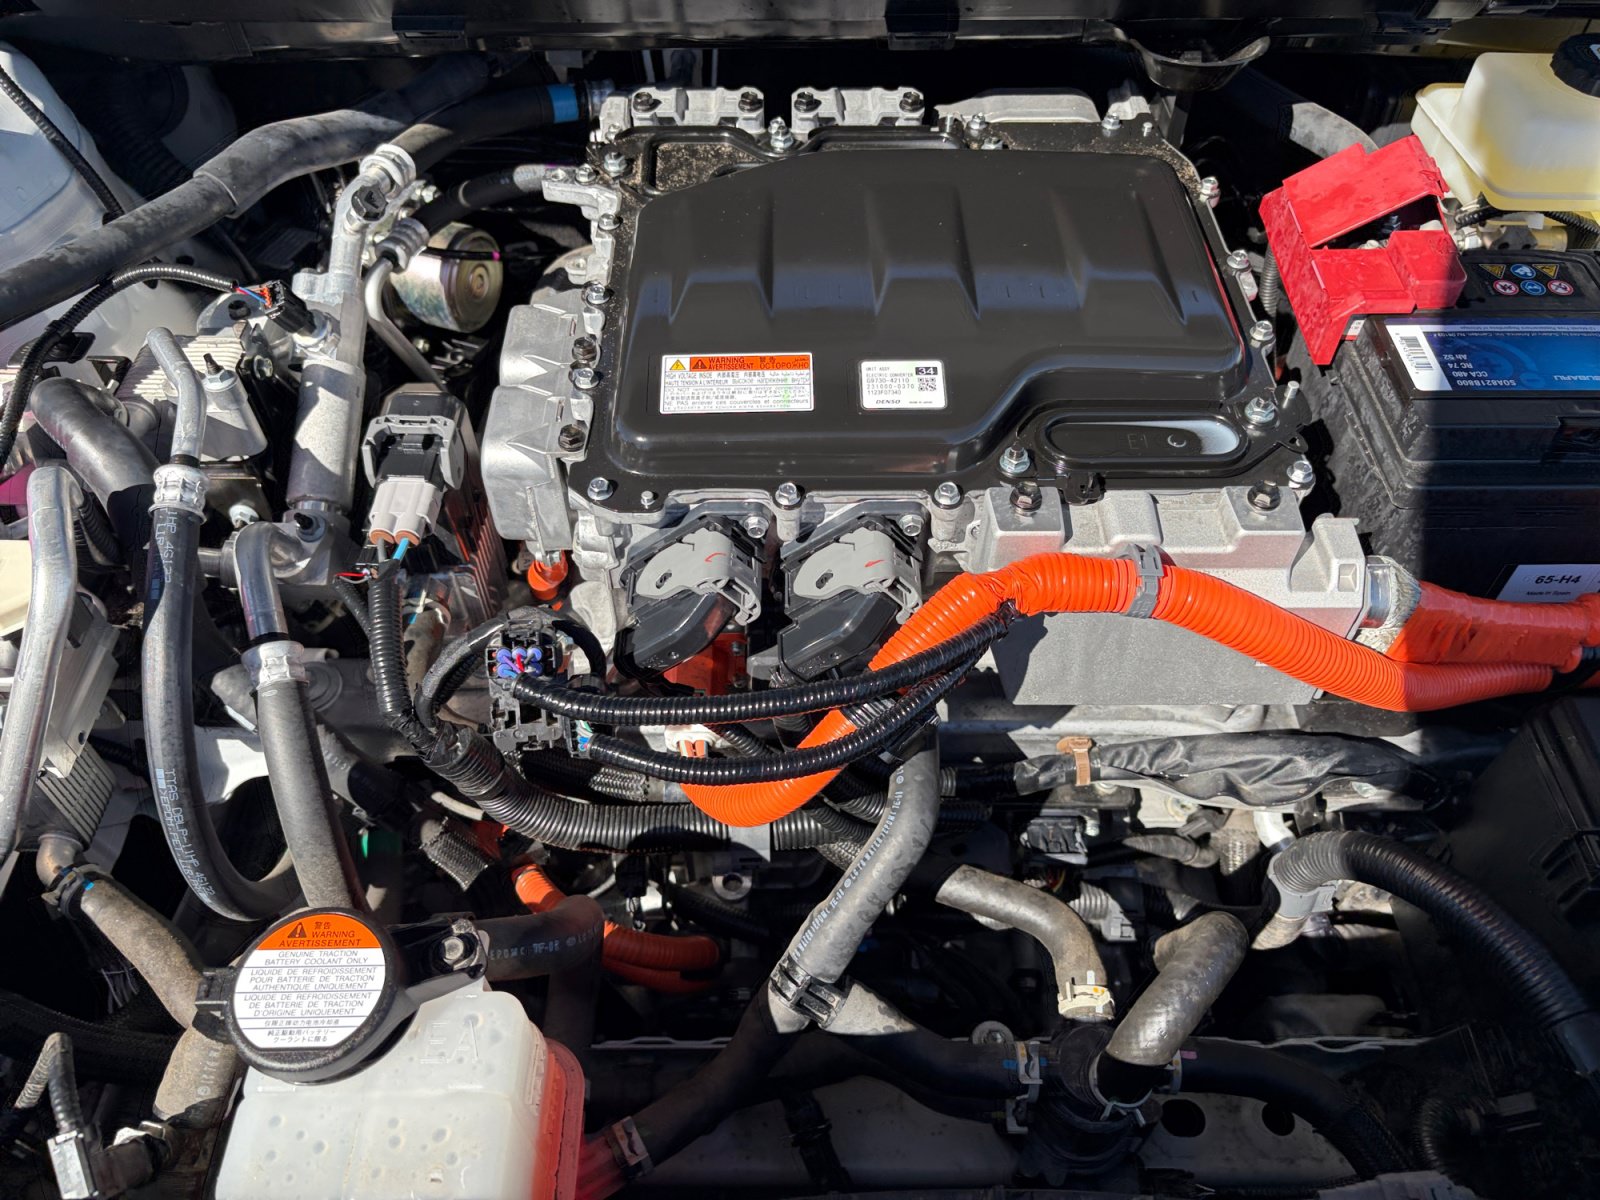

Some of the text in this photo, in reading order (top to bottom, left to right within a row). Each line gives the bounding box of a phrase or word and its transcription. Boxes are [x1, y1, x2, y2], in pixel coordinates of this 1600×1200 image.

[918, 367, 934, 375] 34
[1535, 575, 1582, 584] 65-H4
[314, 921, 331, 930] 警告
[279, 939, 362, 948] AVERTISSEMENT
[302, 967, 377, 975] REFROIDISSEMENT
[296, 992, 372, 1000] REFROIDISSEMENT
[264, 1001, 303, 1009] BATTERIE
[254, 1009, 297, 1017] D'ORIGINE
